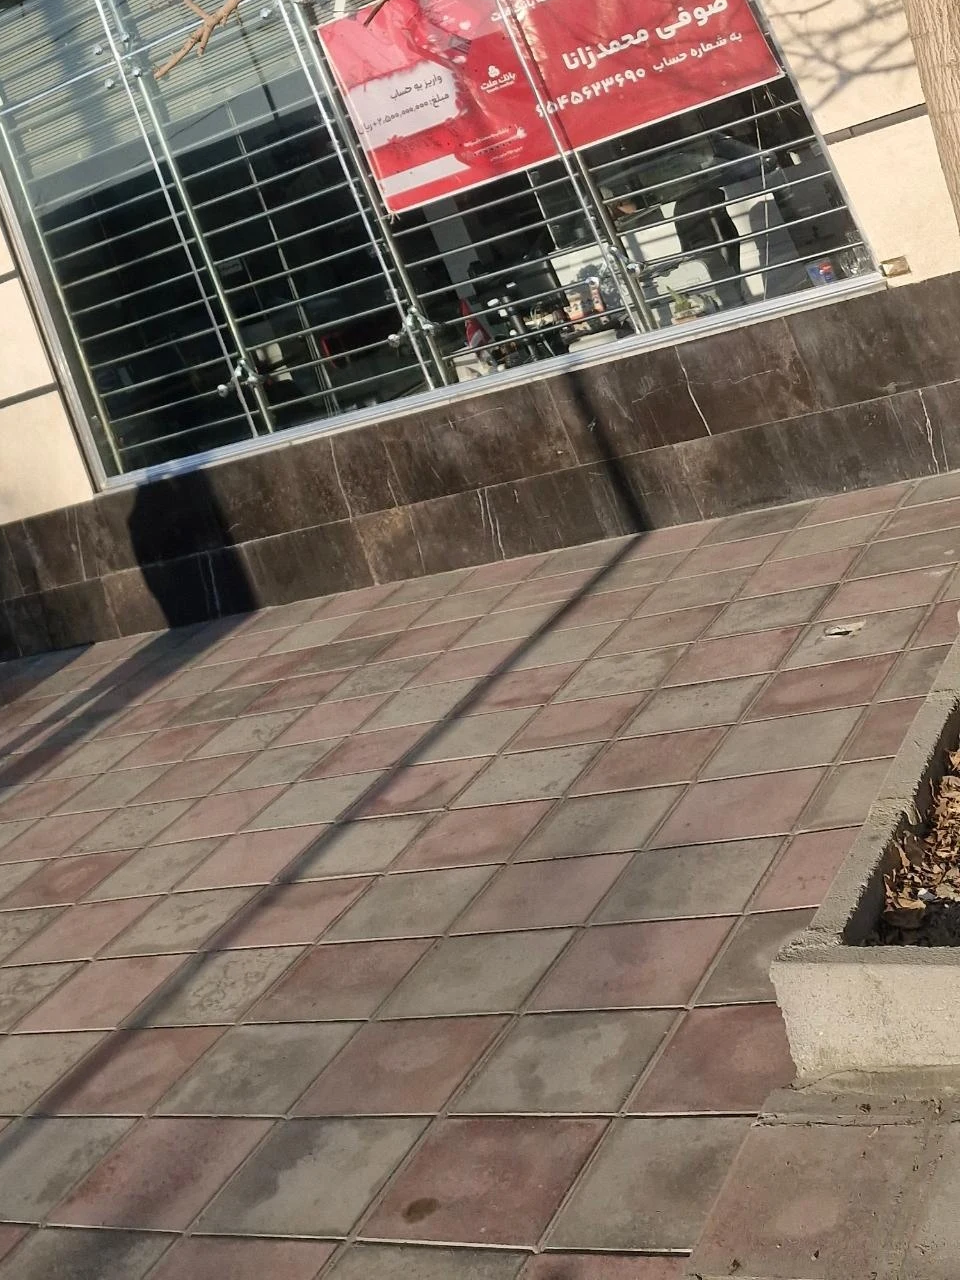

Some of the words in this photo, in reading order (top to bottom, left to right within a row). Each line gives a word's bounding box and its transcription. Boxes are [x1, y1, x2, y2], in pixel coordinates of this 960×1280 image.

[729, 30, 743, 44] به
[690, 36, 728, 59] شماره
[651, 51, 688, 72] حساب
[424, 72, 443, 90] واریز
[390, 85, 413, 101] حساب
